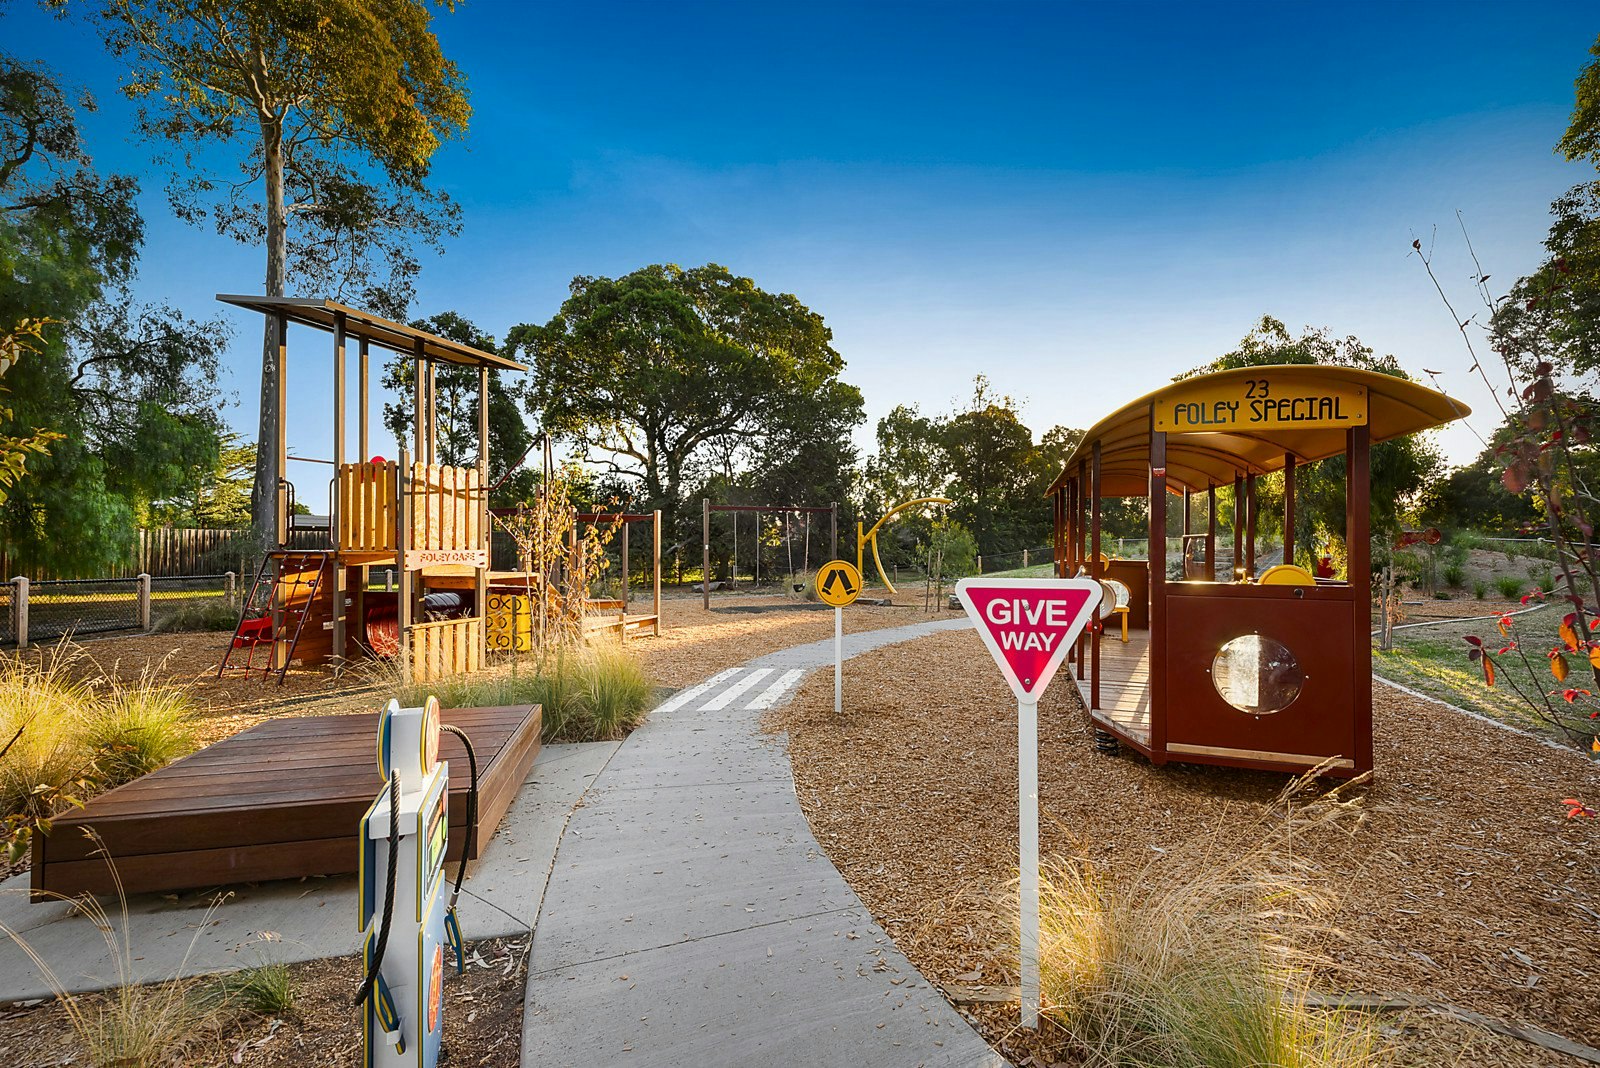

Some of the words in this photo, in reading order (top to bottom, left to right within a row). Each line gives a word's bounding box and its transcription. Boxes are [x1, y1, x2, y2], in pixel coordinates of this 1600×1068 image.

[1245, 379, 1270, 399] 23
[1174, 400, 1240, 425] FOLEY
[1249, 396, 1349, 422] SPECIAL
[420, 552, 451, 563] FOLEY
[452, 552, 476, 562] CAFE
[986, 598, 1068, 627] GIVE
[1000, 631, 1056, 652] WAY
